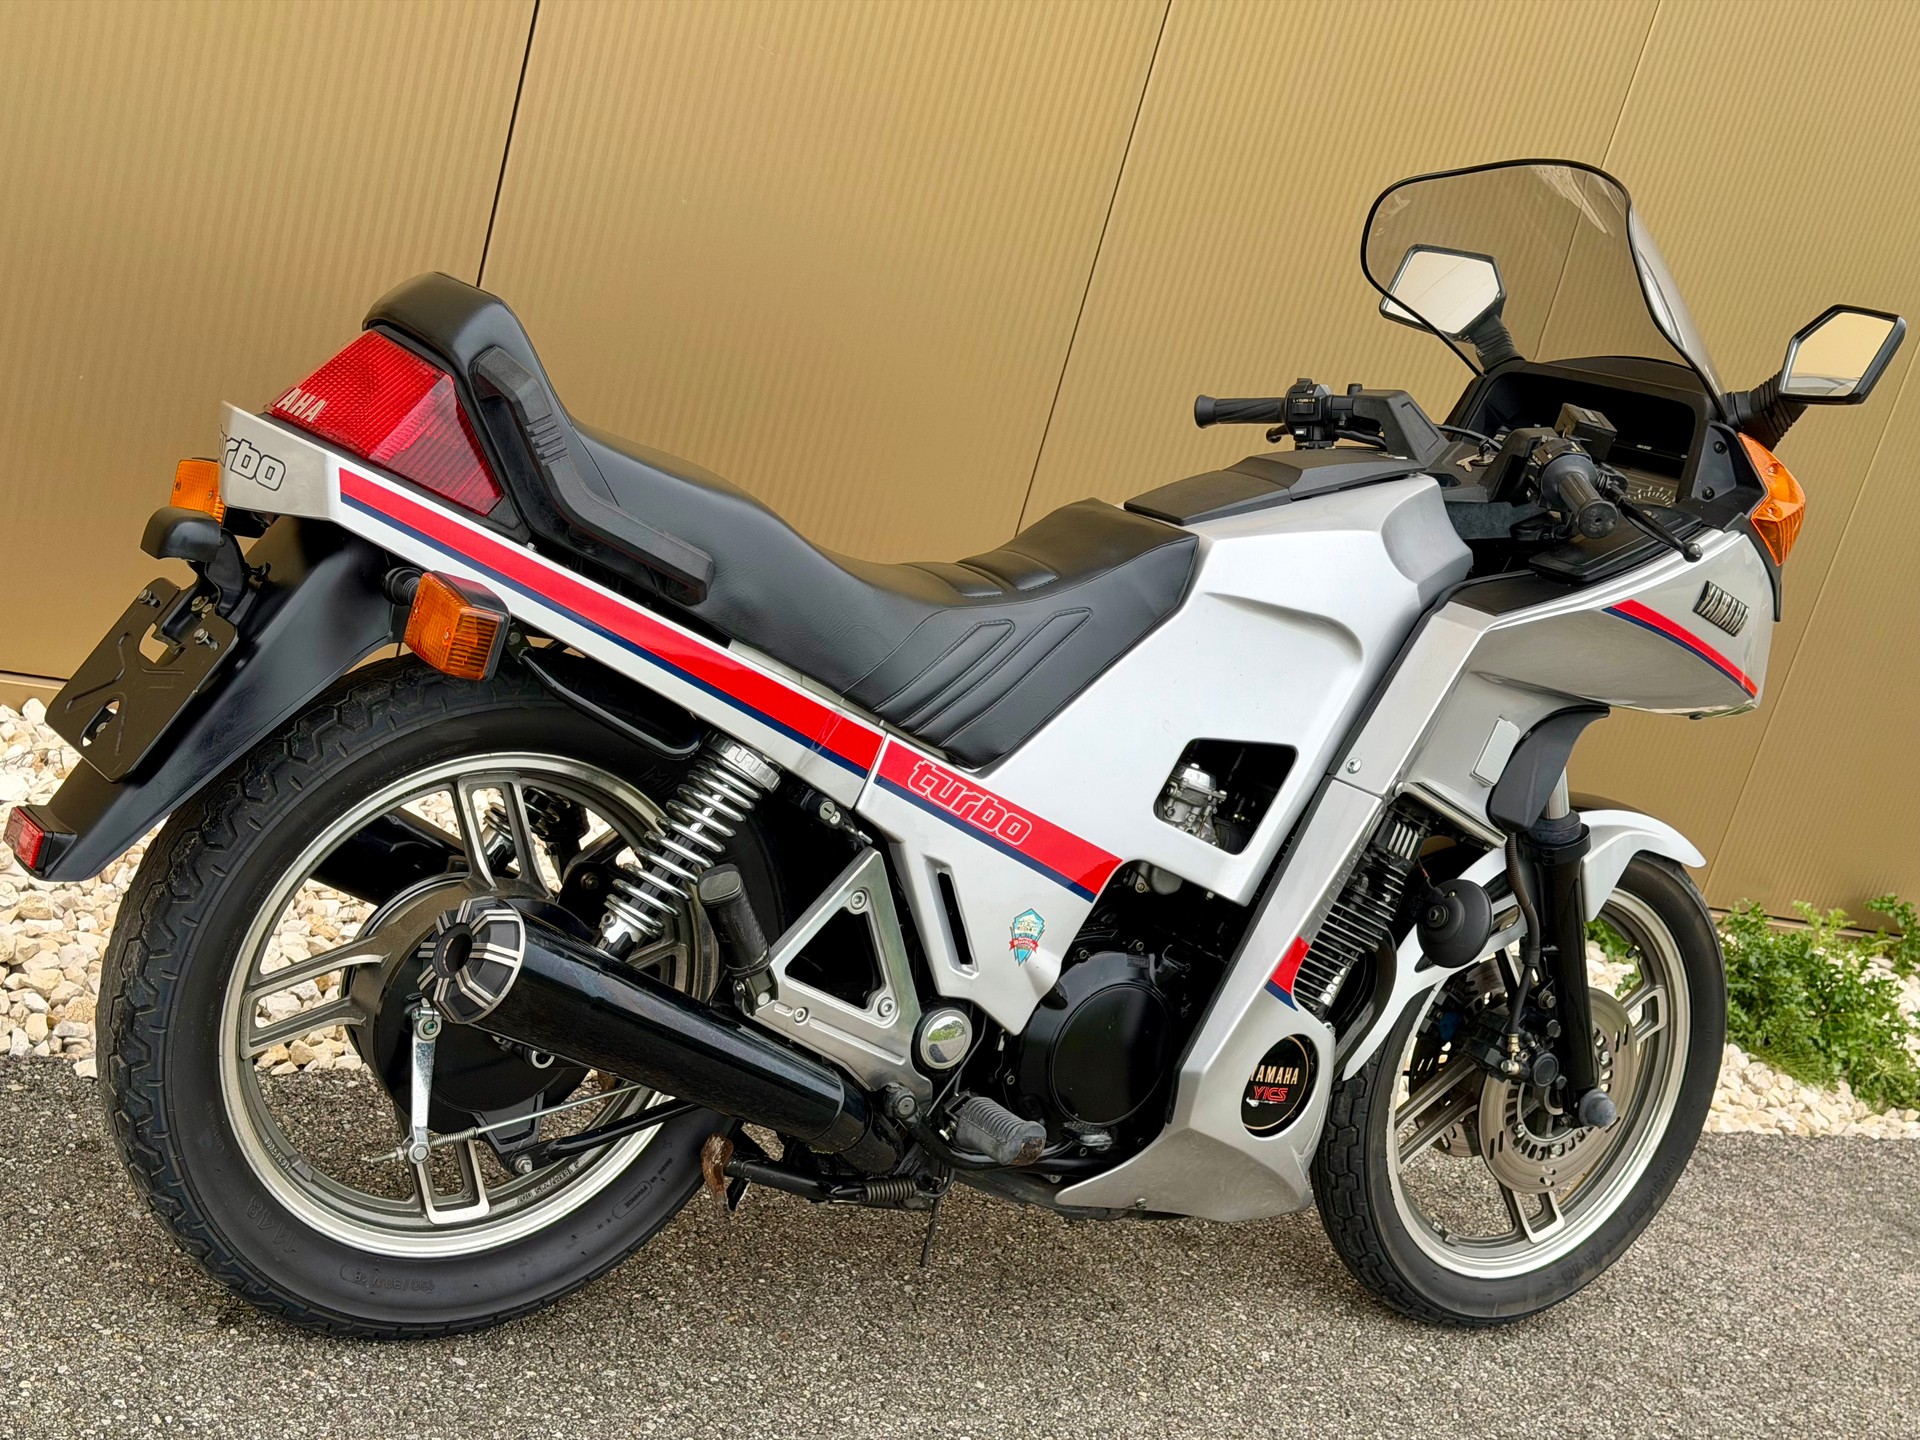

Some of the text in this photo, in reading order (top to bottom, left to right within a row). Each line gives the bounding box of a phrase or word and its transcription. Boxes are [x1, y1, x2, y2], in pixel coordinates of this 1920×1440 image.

[275, 387, 326, 423] AHA
[219, 424, 286, 491] rbo
[1696, 582, 1749, 636] YAMAHA
[908, 760, 1032, 845] turbo
[1253, 1085, 1288, 1102] YICS
